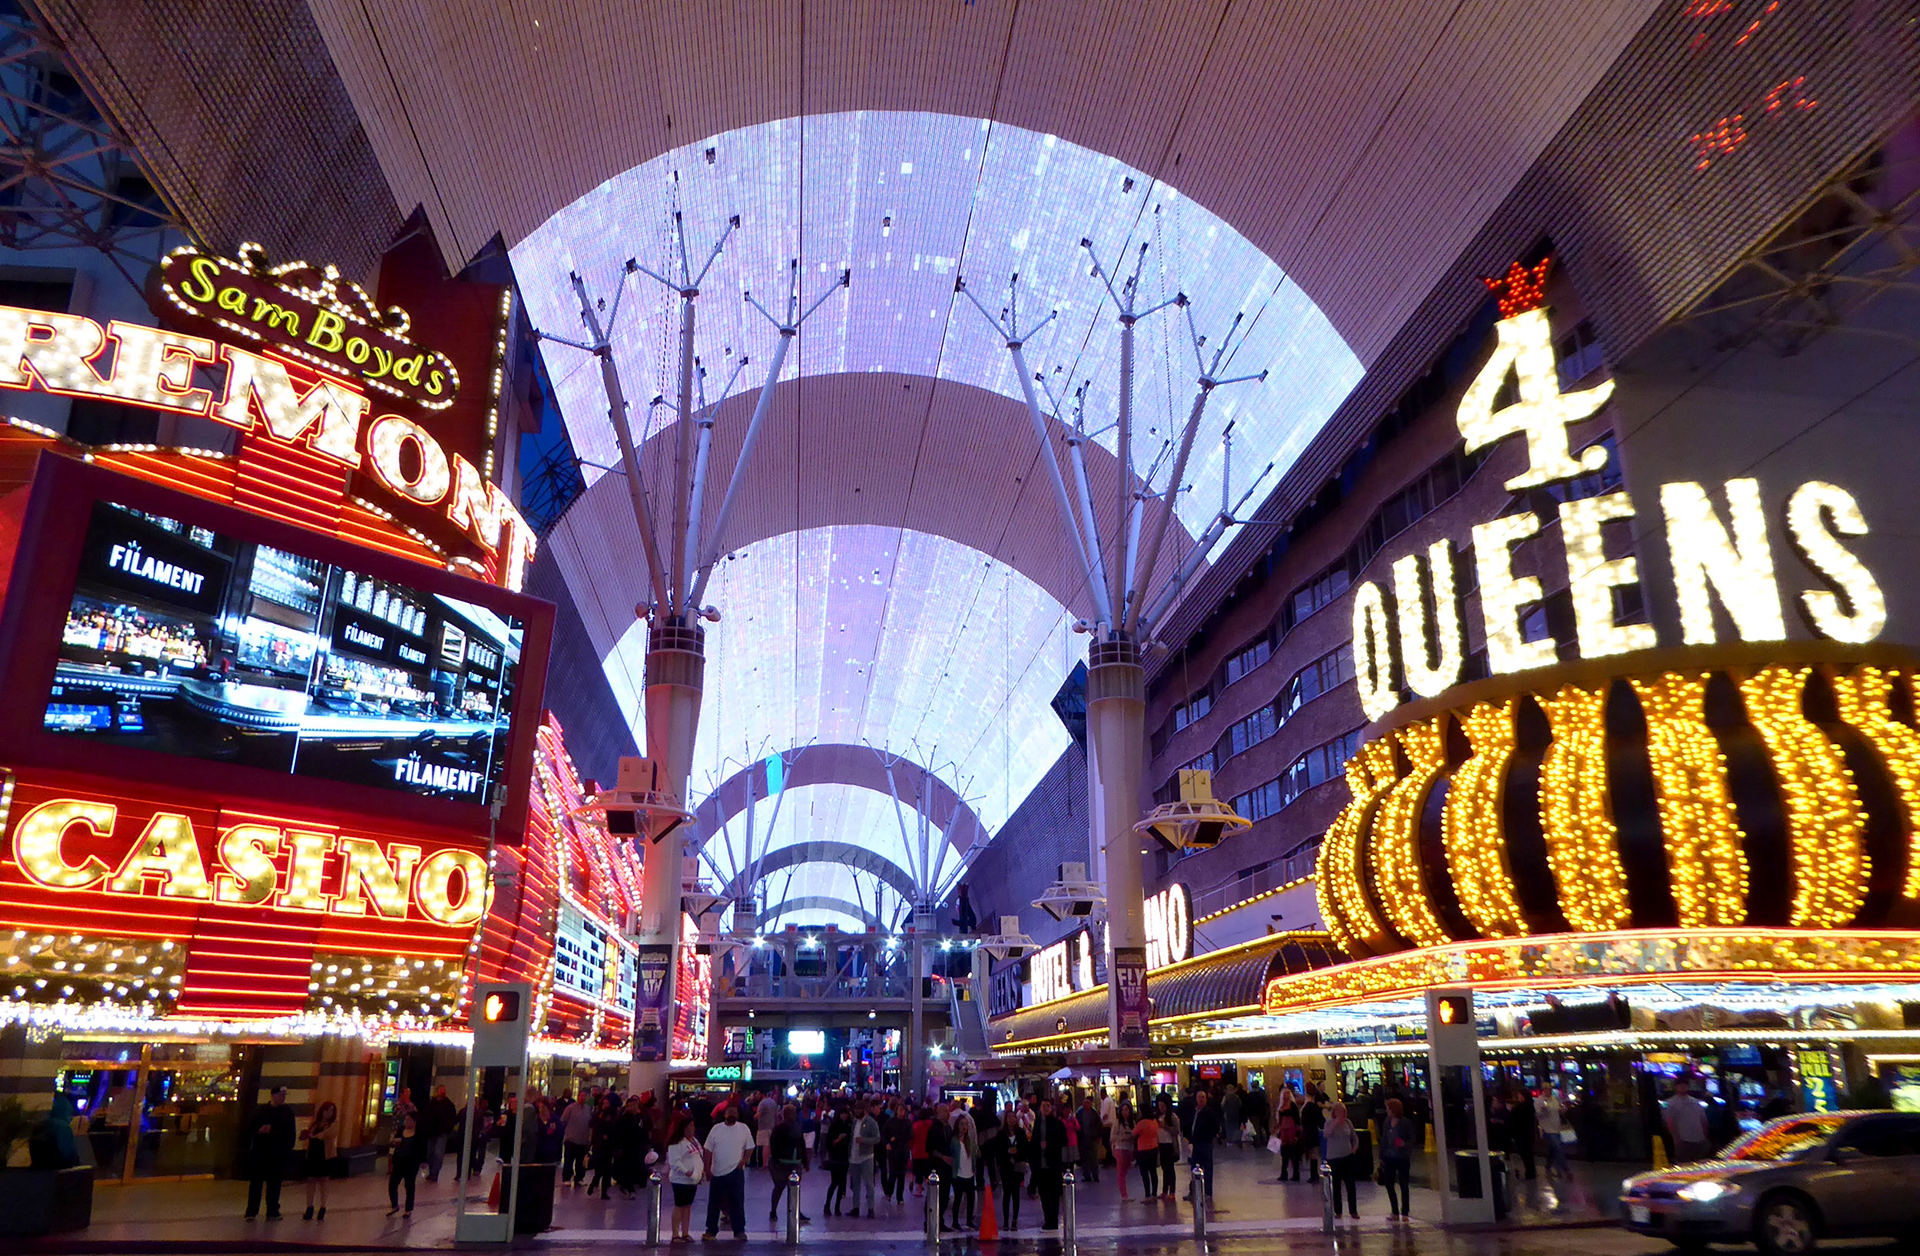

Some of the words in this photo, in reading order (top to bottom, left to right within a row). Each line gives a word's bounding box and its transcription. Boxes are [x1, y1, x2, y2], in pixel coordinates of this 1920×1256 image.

[181, 256, 301, 336] Sam
[305, 308, 445, 396] Boyd's
[1456, 306, 1617, 492] 4
[109, 545, 205, 595] FILAMENT
[1352, 478, 1888, 723] QUEENS
[344, 624, 385, 651] FILAMENT
[399, 644, 427, 666] FILAMENT
[395, 757, 482, 794] FILAMENT
[12, 797, 495, 928] CASINO
[1030, 939, 1073, 1006] HOTEL
[1117, 967, 1146, 987] FLY
[706, 1066, 742, 1079] CIGARS
